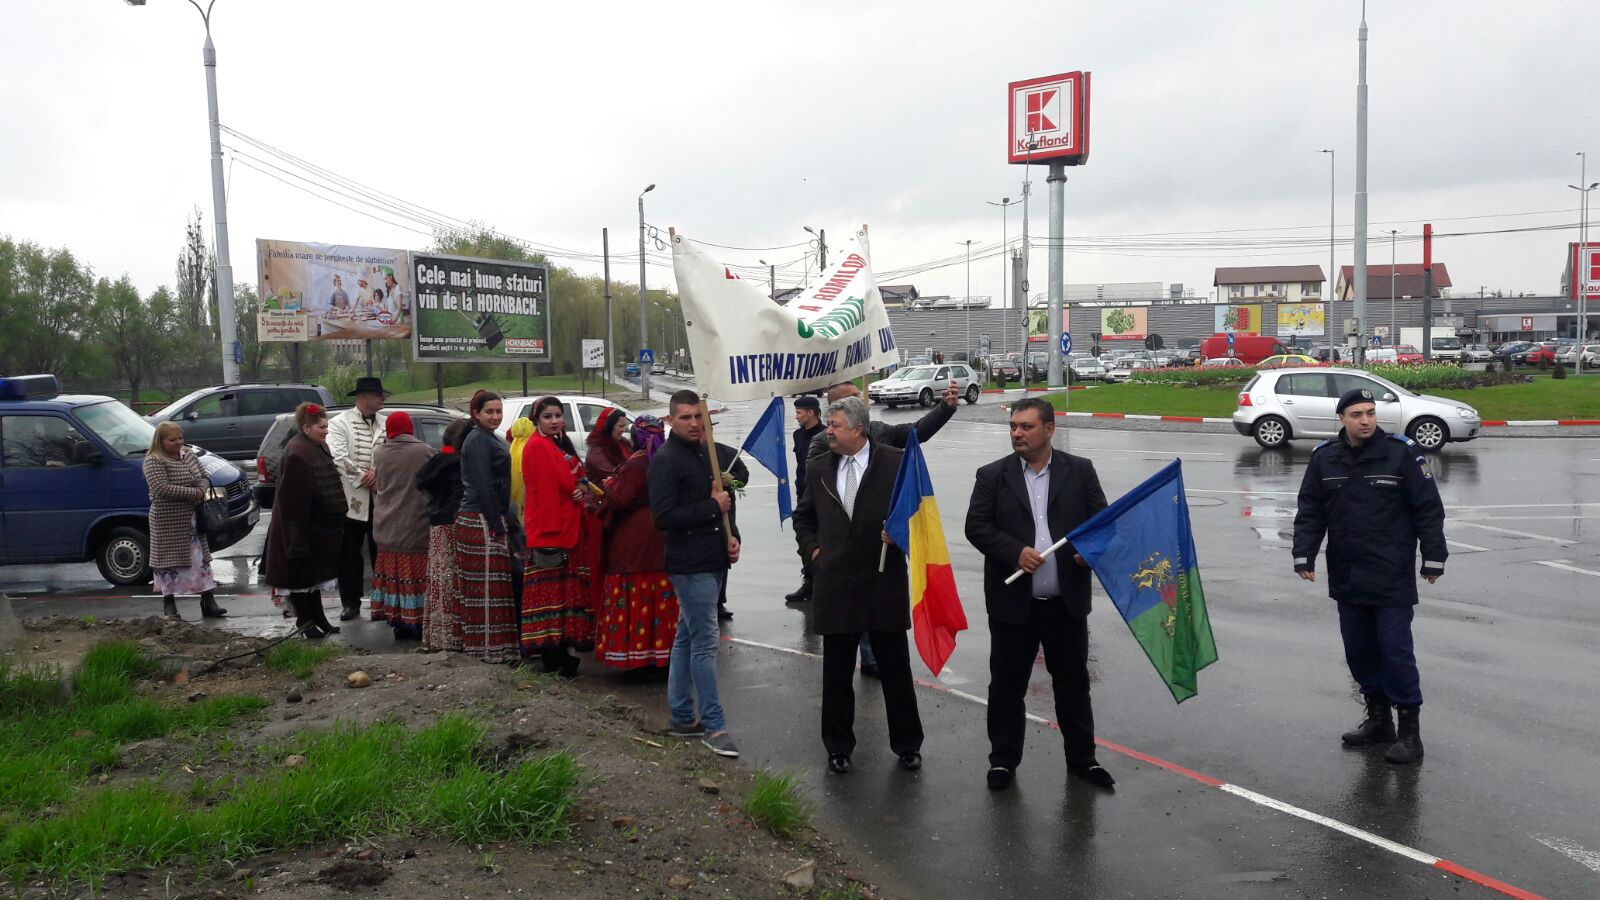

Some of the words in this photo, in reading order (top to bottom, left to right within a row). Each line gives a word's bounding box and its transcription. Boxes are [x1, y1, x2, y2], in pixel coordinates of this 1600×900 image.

[268, 249, 294, 259] Familia
[295, 252, 314, 260] mare
[355, 255, 364, 263] de
[417, 263, 446, 285] Cele
[450, 268, 471, 287] mai
[475, 269, 502, 290] bune
[506, 273, 542, 293] sfaturi
[418, 289, 438, 309] vin
[443, 291, 458, 310] de
[462, 292, 473, 312] la
[477, 293, 541, 316] HORNBACH.
[505, 339, 537, 347] HORNBACH
[729, 349, 840, 385] INTERNATIONAL
